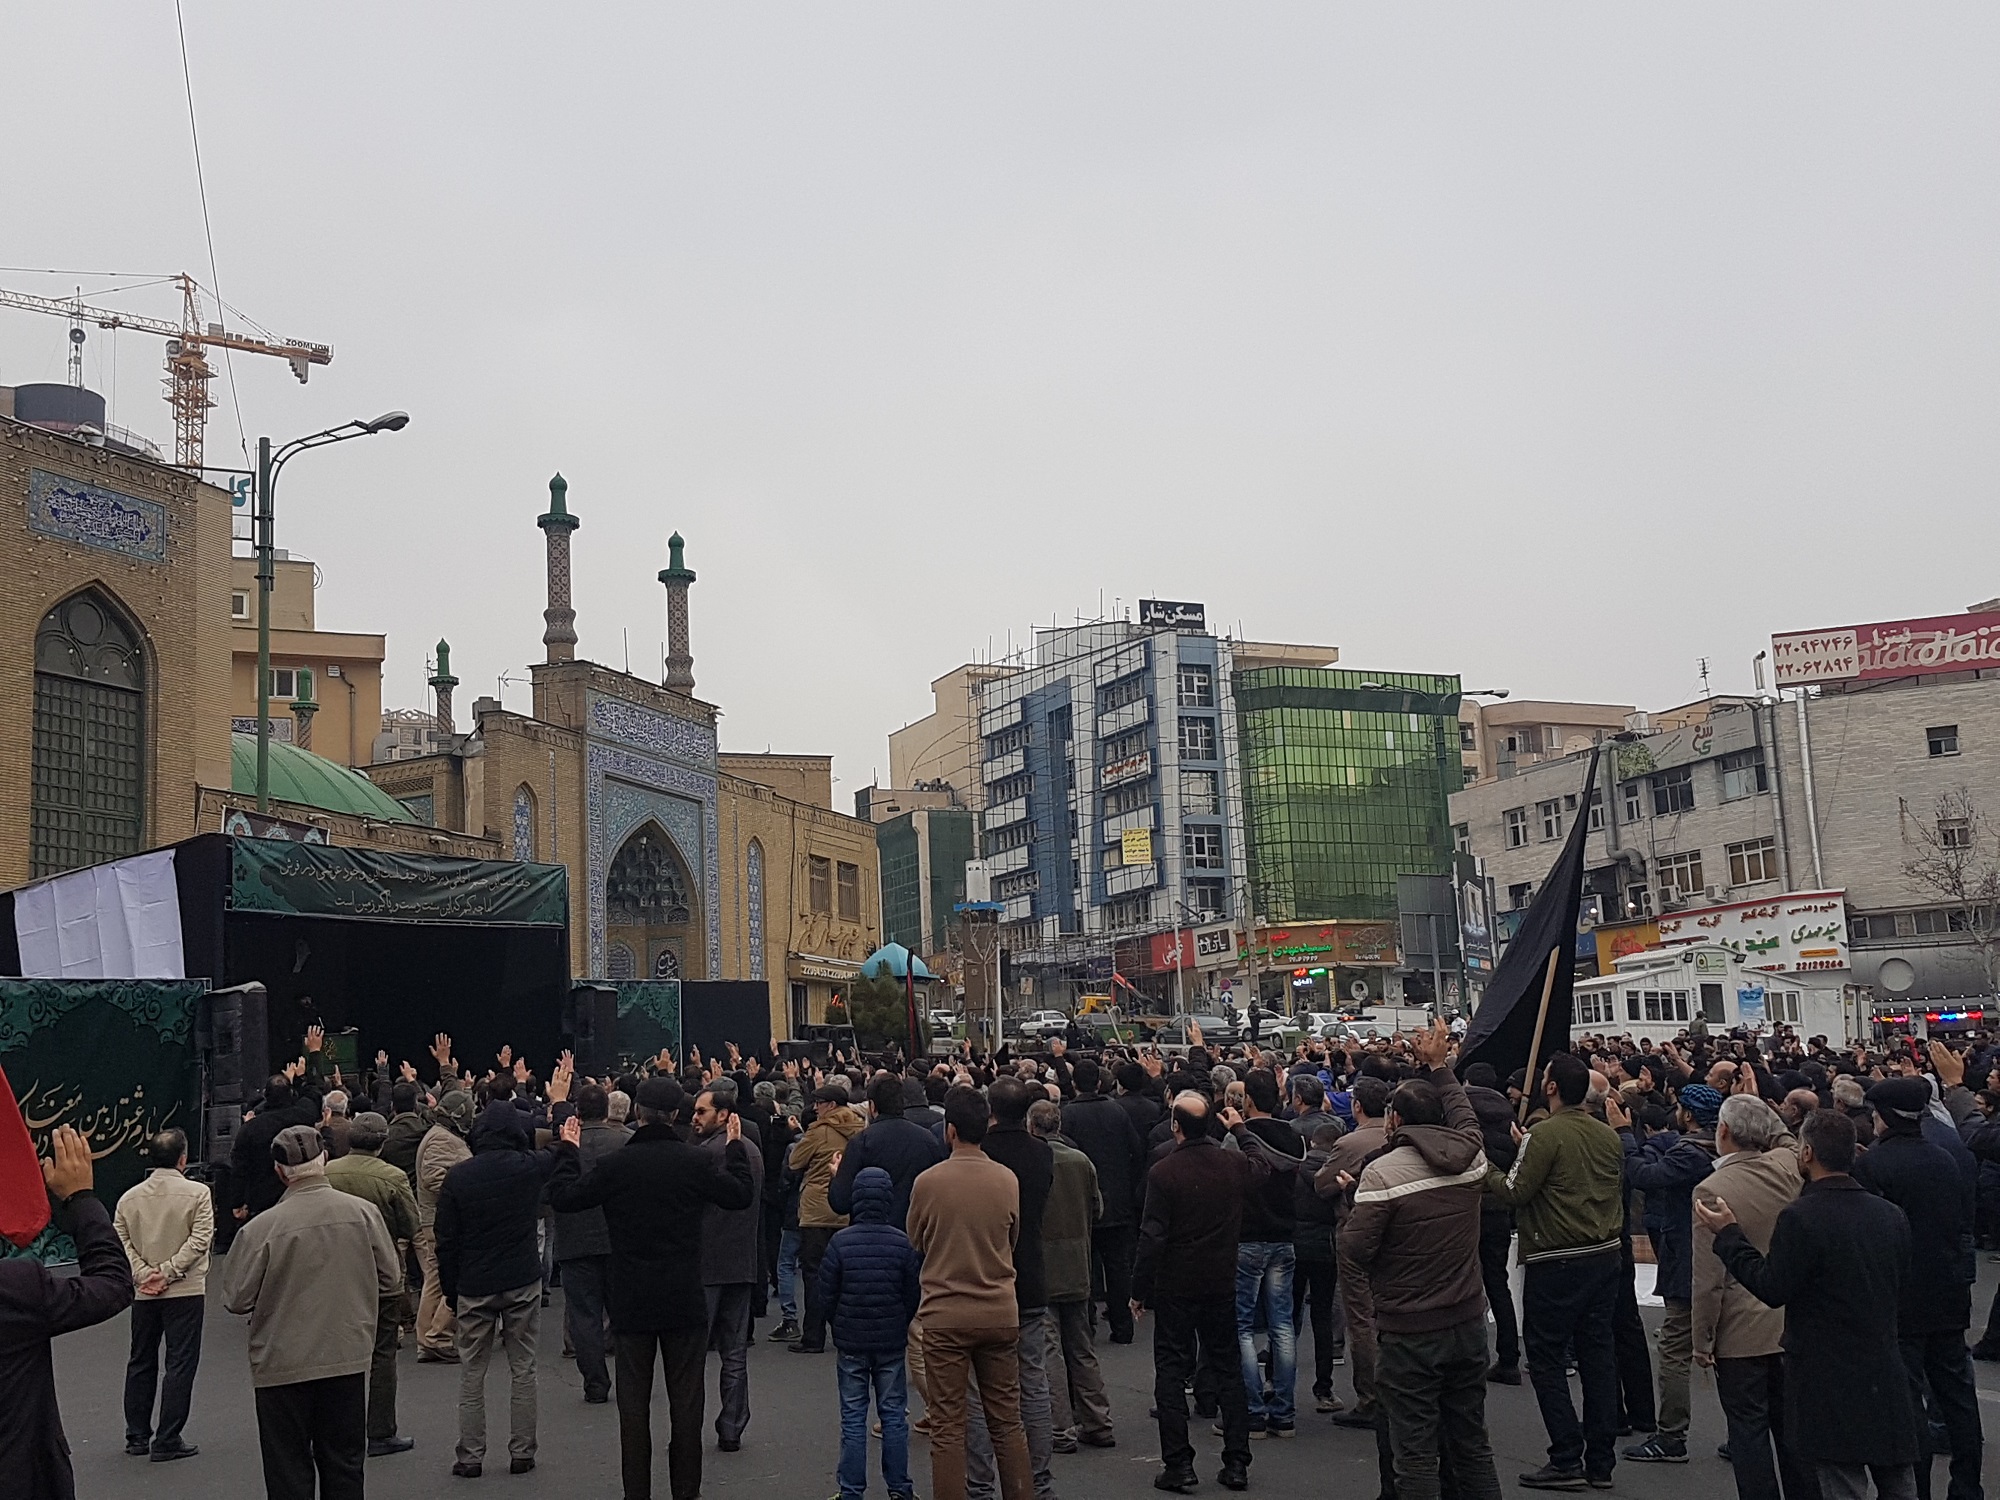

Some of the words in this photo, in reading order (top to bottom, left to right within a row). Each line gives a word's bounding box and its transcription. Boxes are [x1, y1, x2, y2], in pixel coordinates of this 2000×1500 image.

[285, 338, 329, 352] ZOOMLION
[1143, 603, 1165, 623] شار
[1165, 605, 1203, 625] مسکن
[1774, 636, 1853, 658] ۲۲۰۹۴۷۴۶
[1776, 656, 1853, 678] ۲۲۰۶۲۸۹۴
